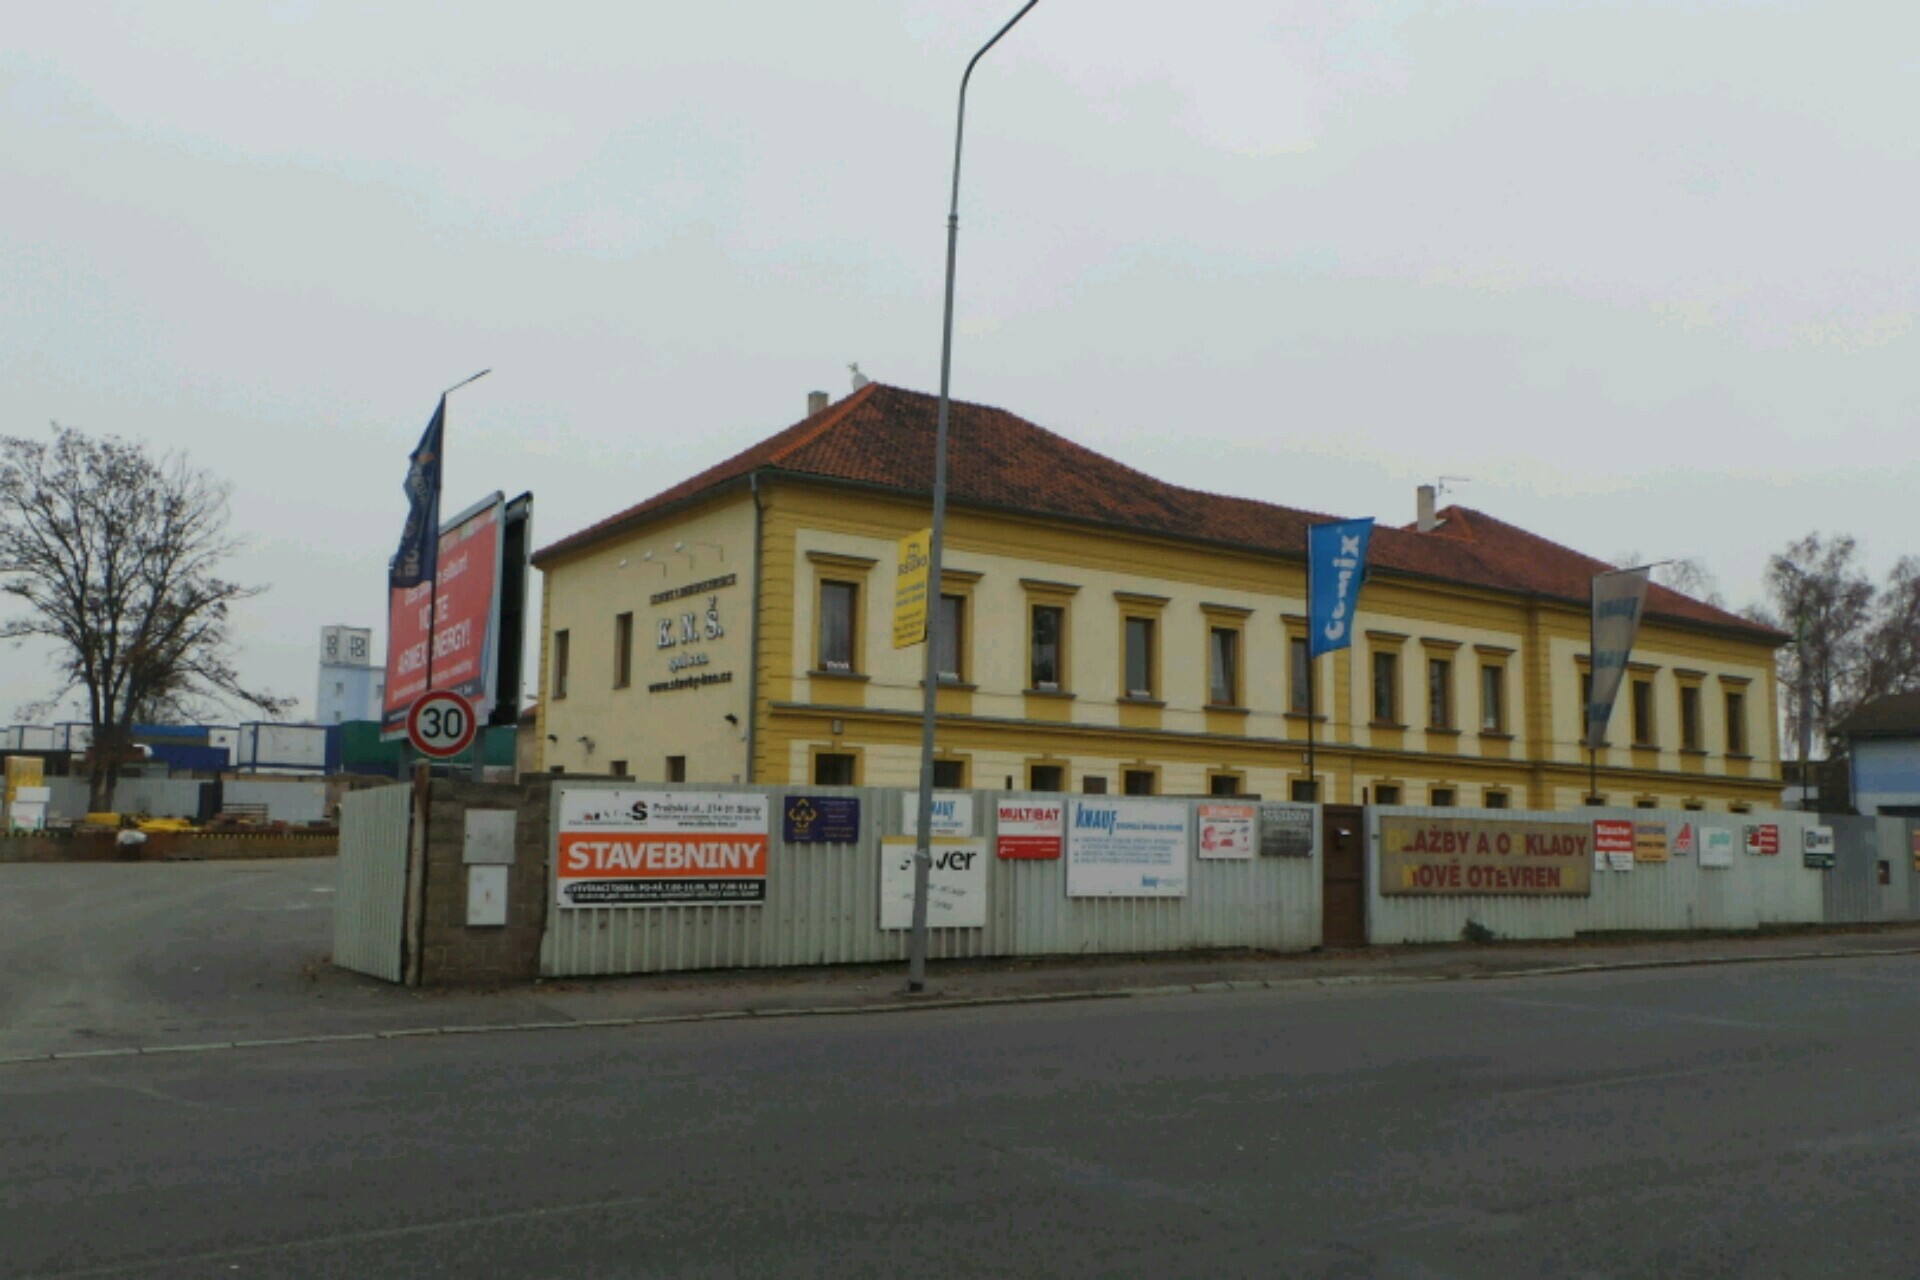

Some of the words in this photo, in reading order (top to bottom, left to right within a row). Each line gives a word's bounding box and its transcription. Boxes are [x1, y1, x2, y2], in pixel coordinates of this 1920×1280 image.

[421, 707, 464, 739] 30
[1000, 808, 1060, 821] MULTIBAT
[568, 841, 761, 870] STAVEBNINY
[1476, 831, 1490, 854] A
